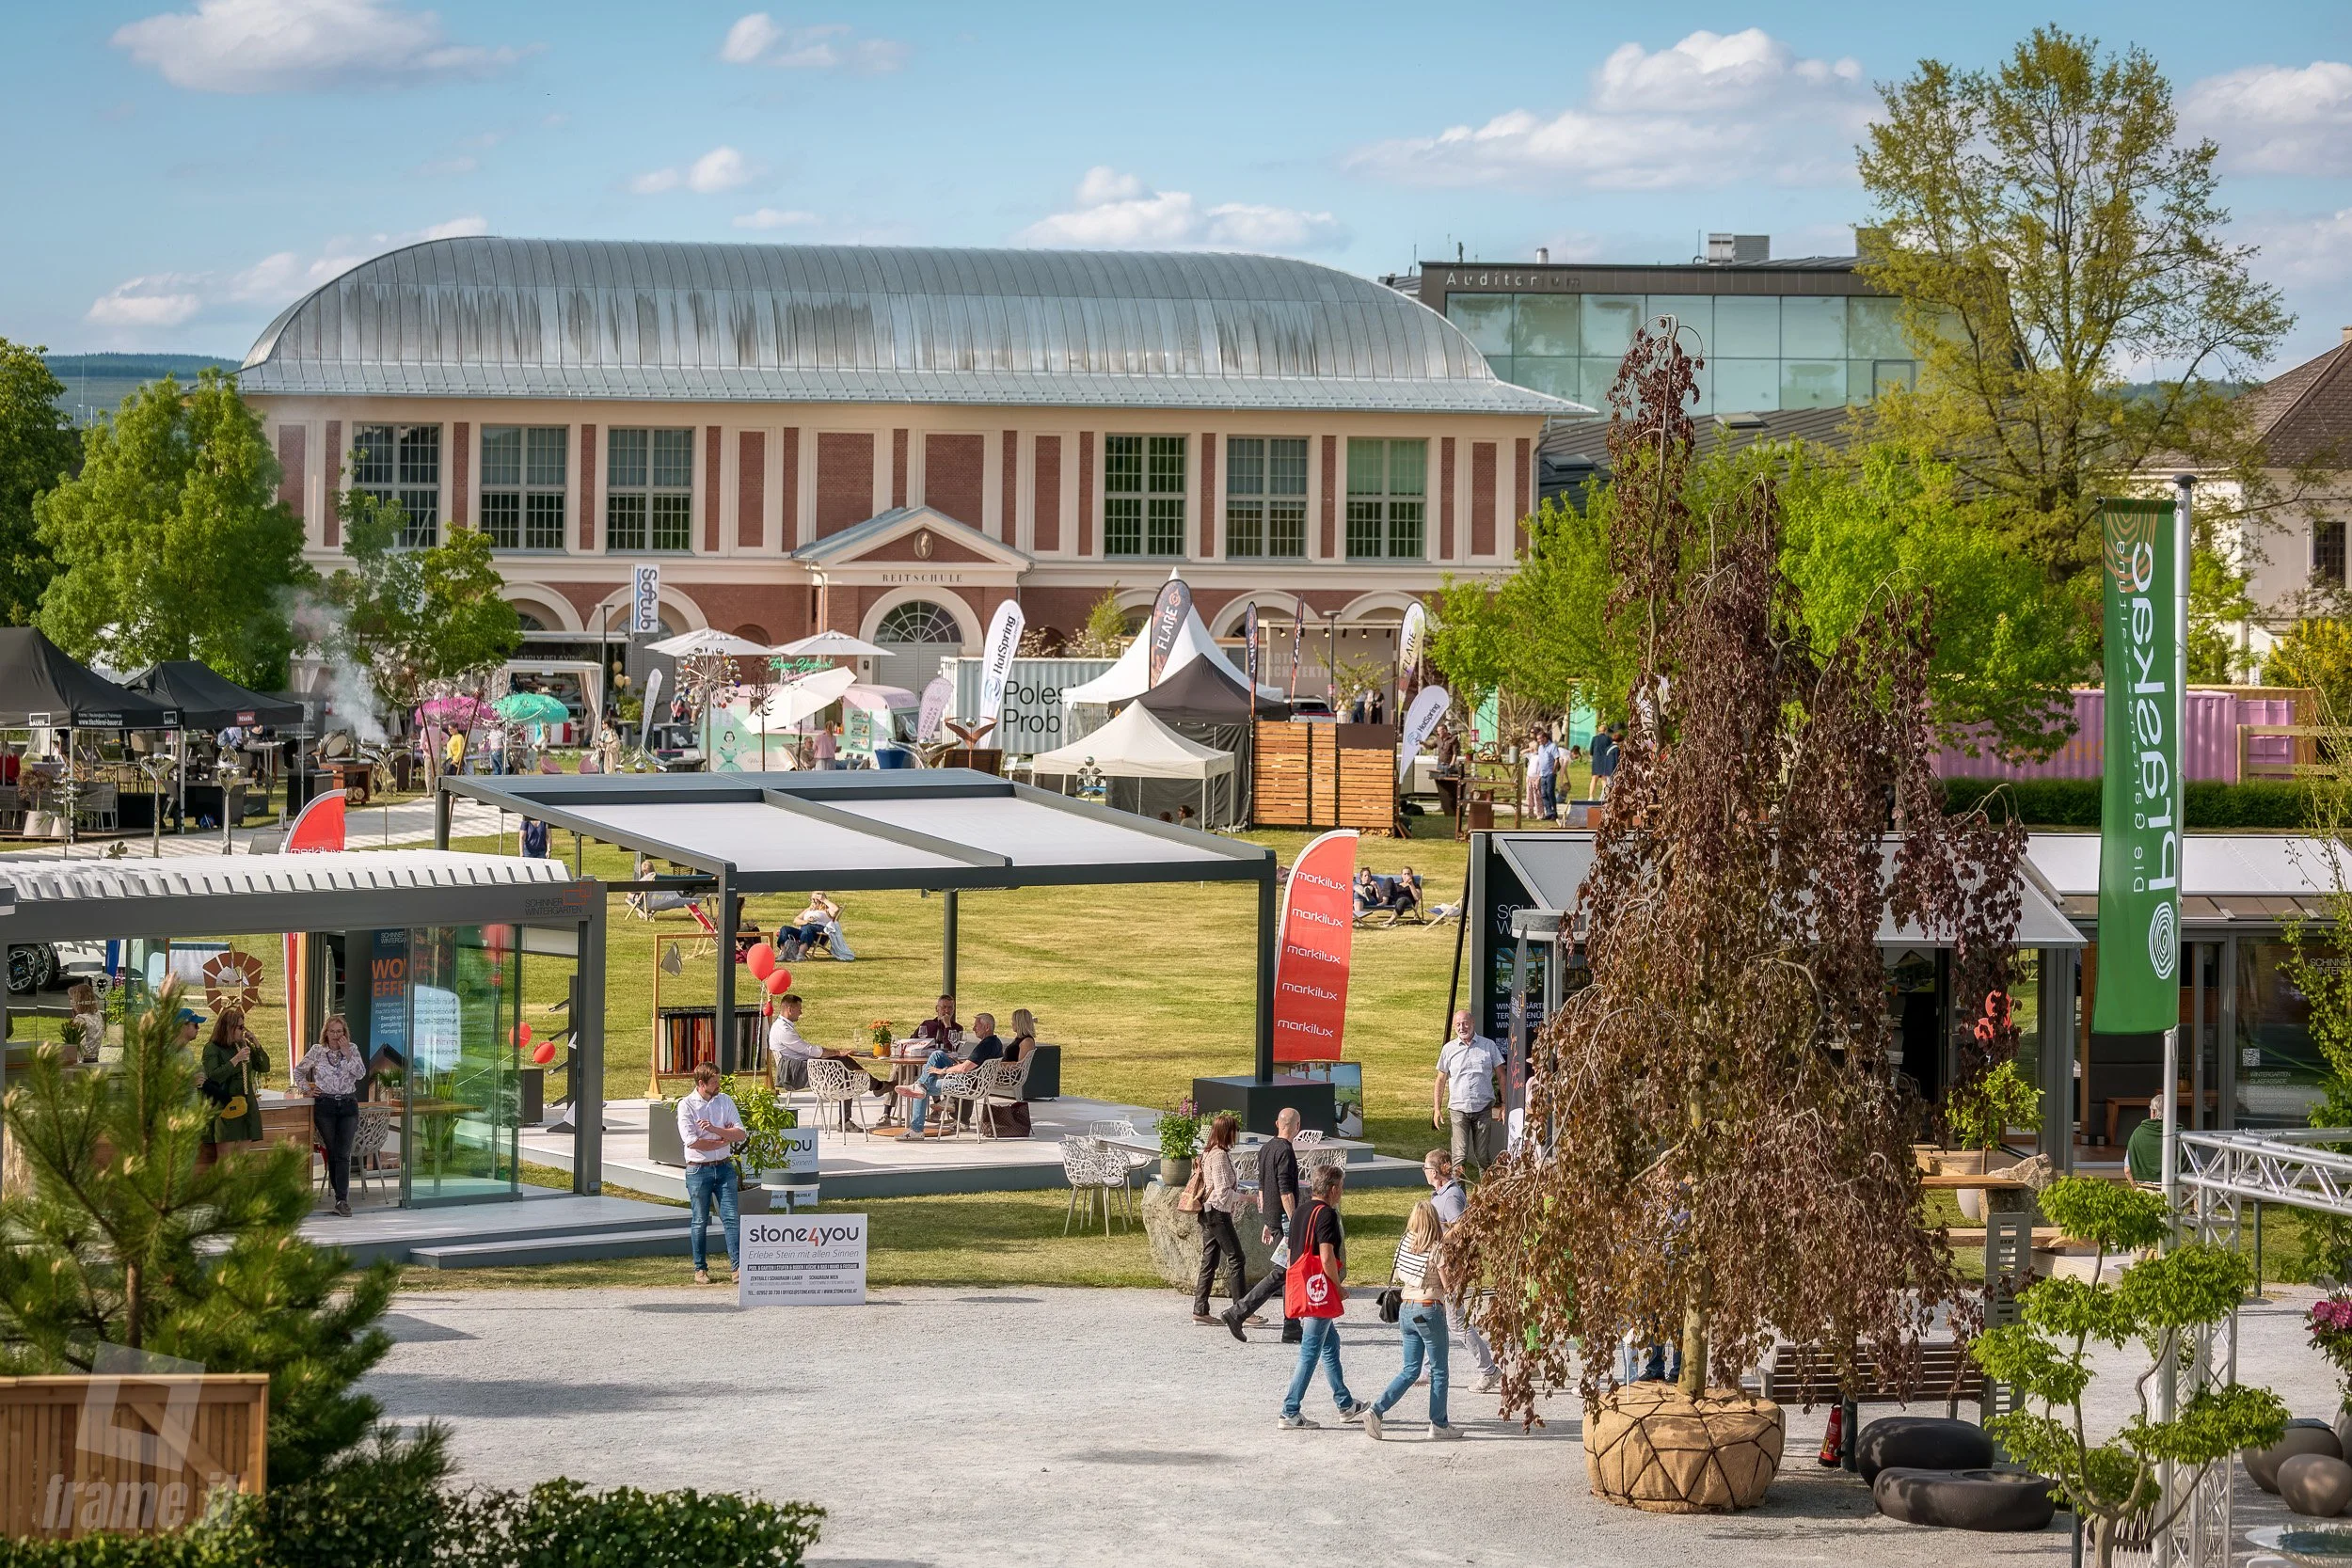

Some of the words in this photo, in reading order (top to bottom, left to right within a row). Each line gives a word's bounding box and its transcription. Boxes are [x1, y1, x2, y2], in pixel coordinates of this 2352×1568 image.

[1446, 272, 1581, 286] Auditorium
[882, 574, 962, 582] REITSCHULE
[640, 568, 658, 630] Softub
[1156, 605, 1178, 651] FLARE
[993, 614, 1017, 675] HotSpring
[1402, 628, 1417, 673] FLARE
[1004, 681, 1064, 705] Poles
[1003, 709, 1062, 733] Prob
[1418, 703, 1441, 733] HotSpring
[1296, 871, 1346, 892] markilux
[524, 906, 581, 915] WINTERGARTEN
[1292, 908, 1343, 927] markilux
[1287, 945, 1341, 964] markilux
[373, 980, 405, 997] EFFE
[1282, 982, 1338, 1000] markilux
[1278, 1020, 1333, 1037] markilux
[749, 1225, 859, 1247] stone4you
[749, 1250, 773, 1259] Erlebe
[776, 1250, 796, 1259] Stein
[797, 1250, 809, 1259] mit
[810, 1249, 830, 1259] allen
[832, 1249, 859, 1258] Sinnen
